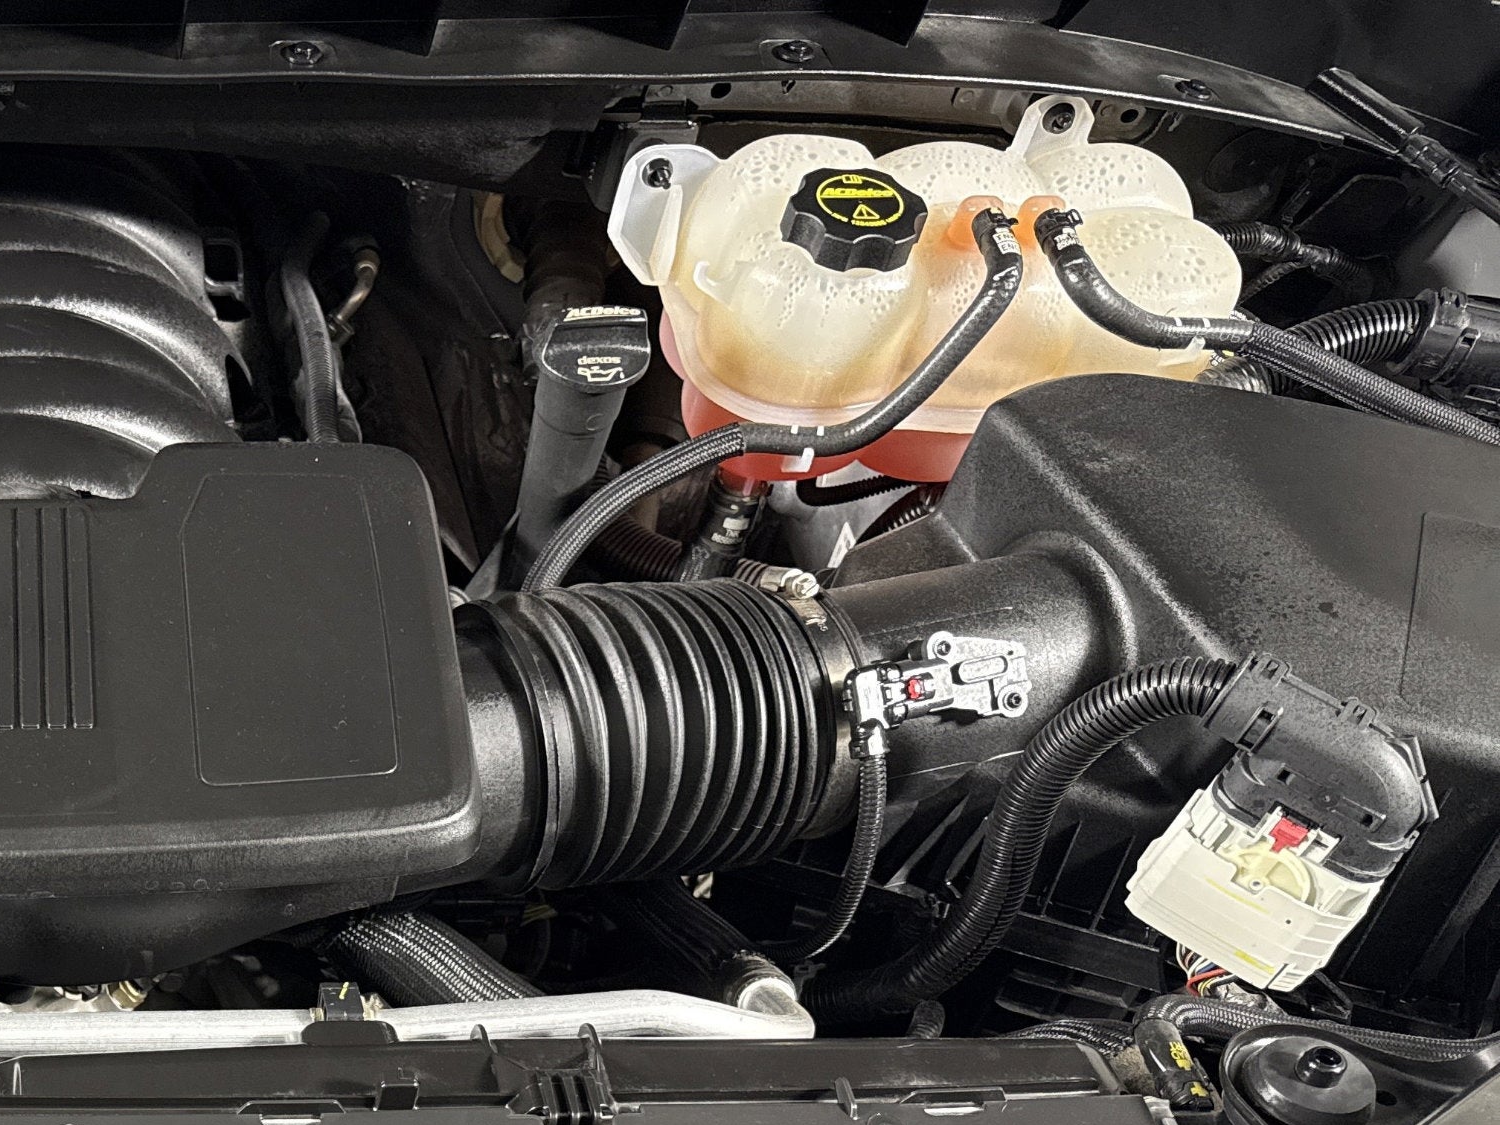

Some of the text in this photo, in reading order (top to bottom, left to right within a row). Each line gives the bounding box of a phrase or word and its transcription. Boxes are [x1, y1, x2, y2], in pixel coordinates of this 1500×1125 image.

[822, 187, 894, 197] ACDelco
[565, 306, 641, 320] ACDelco
[577, 355, 622, 365] dexos
